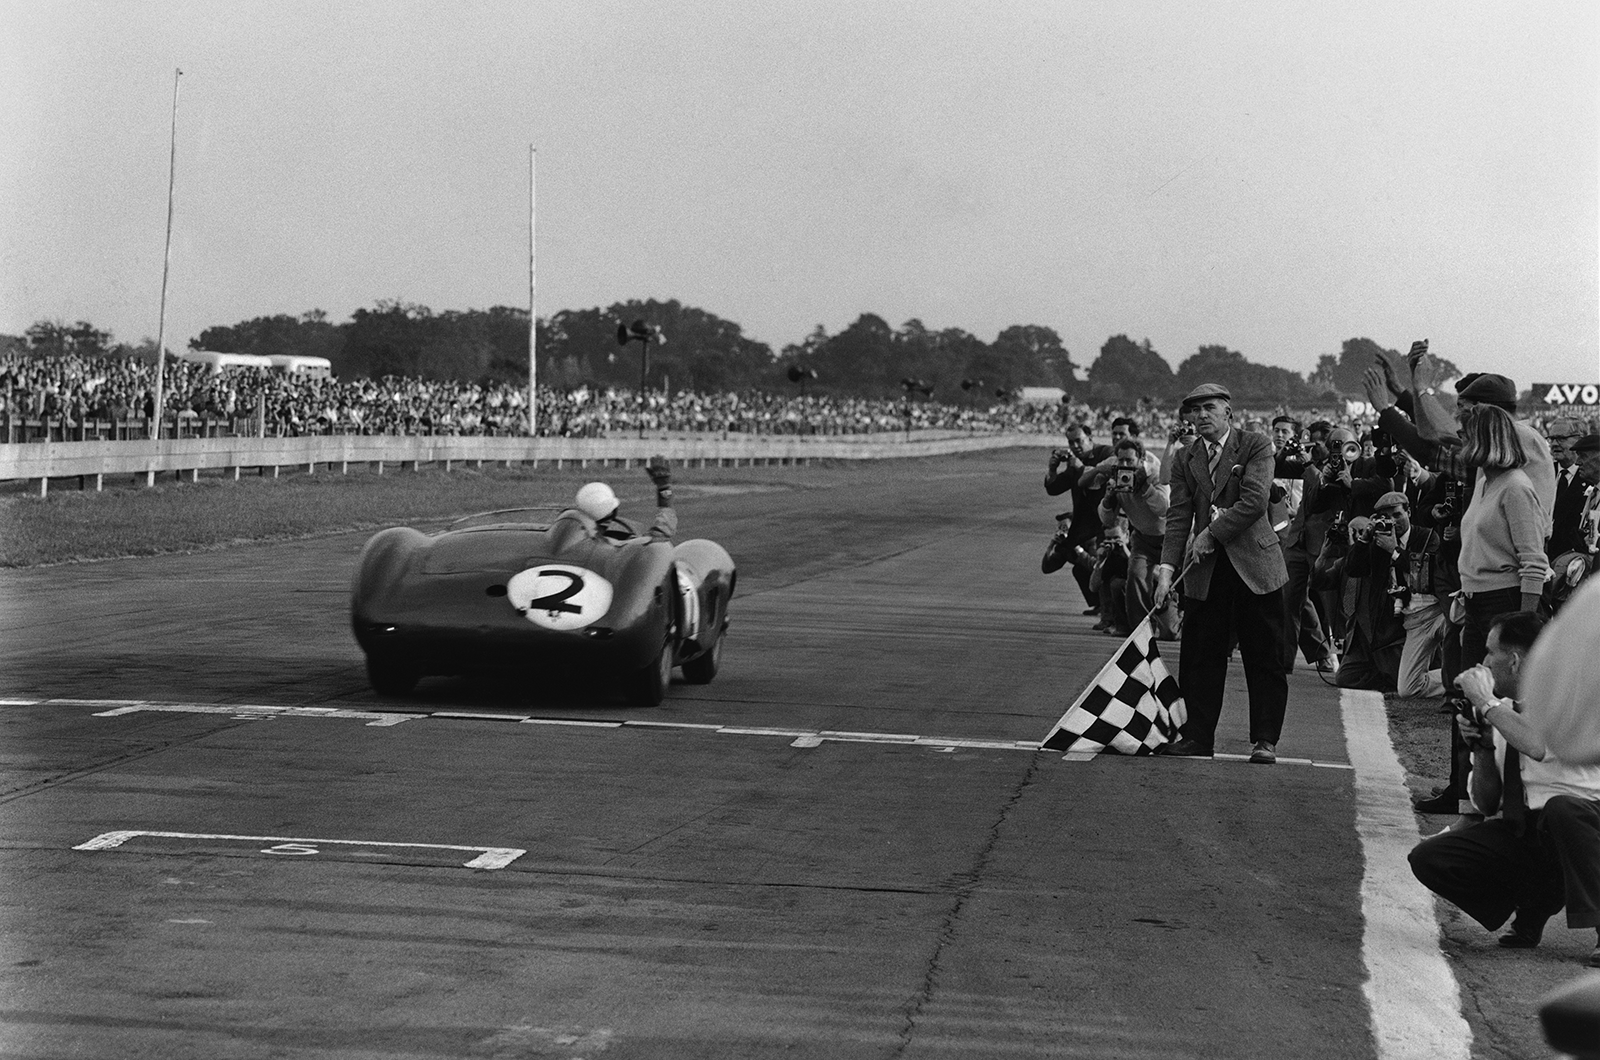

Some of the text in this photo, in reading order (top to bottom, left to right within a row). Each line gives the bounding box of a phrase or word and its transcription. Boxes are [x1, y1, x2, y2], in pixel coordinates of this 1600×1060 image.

[1544, 384, 1599, 405] AVO
[531, 570, 584, 614] 2
[260, 843, 319, 855] 5
